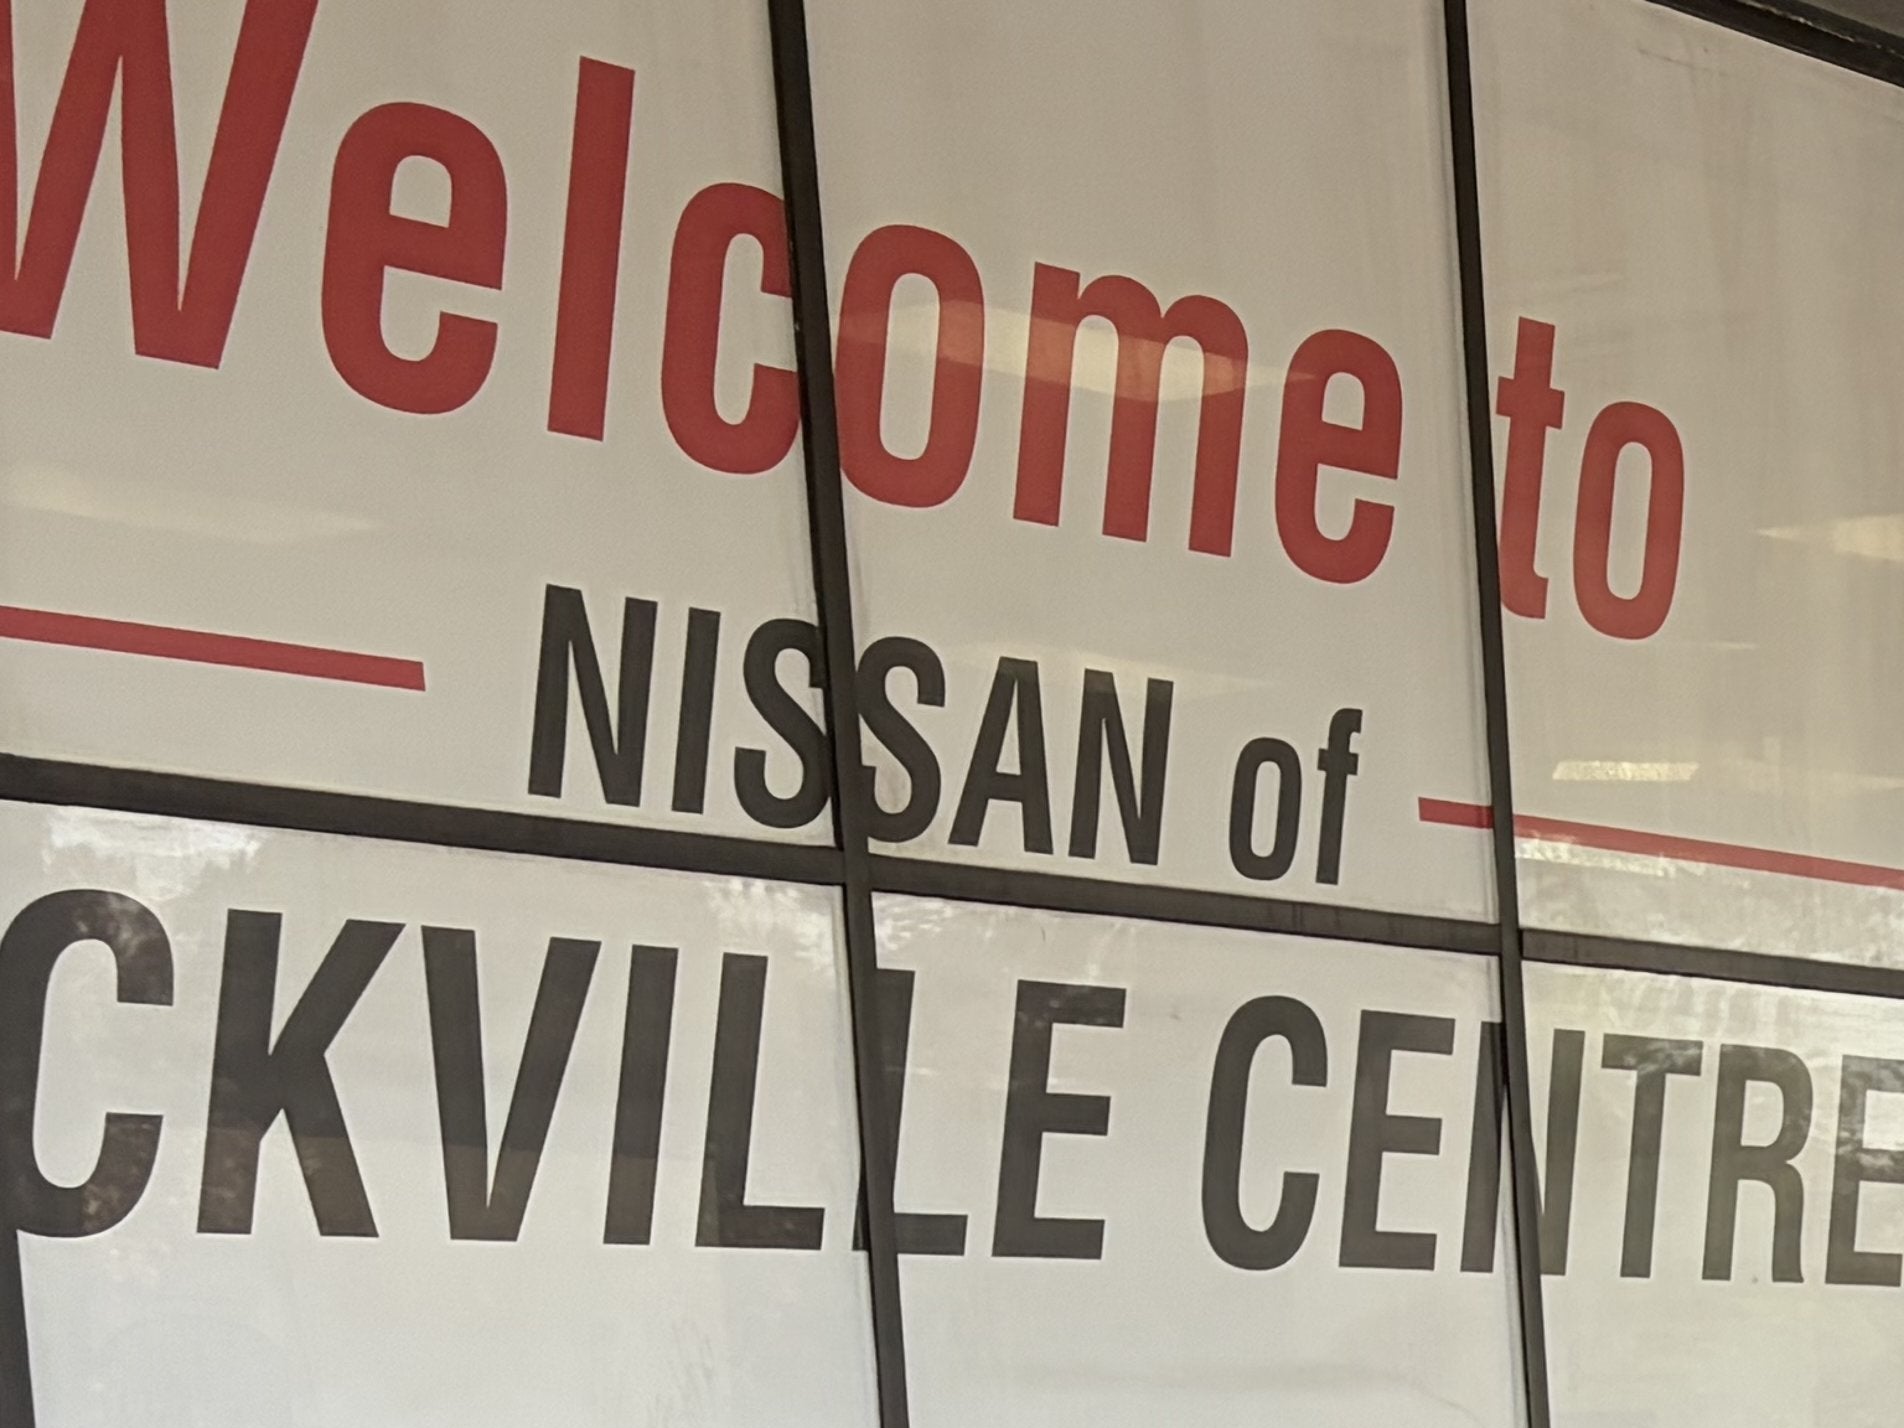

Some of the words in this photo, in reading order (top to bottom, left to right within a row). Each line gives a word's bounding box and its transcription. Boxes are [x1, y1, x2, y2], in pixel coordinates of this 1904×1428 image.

[0, 0, 1404, 584] Welcome
[1496, 317, 1685, 640] to
[525, 585, 1174, 866] NISSAN
[1228, 707, 1363, 886] of
[0, 888, 1129, 1265] CKVILLE
